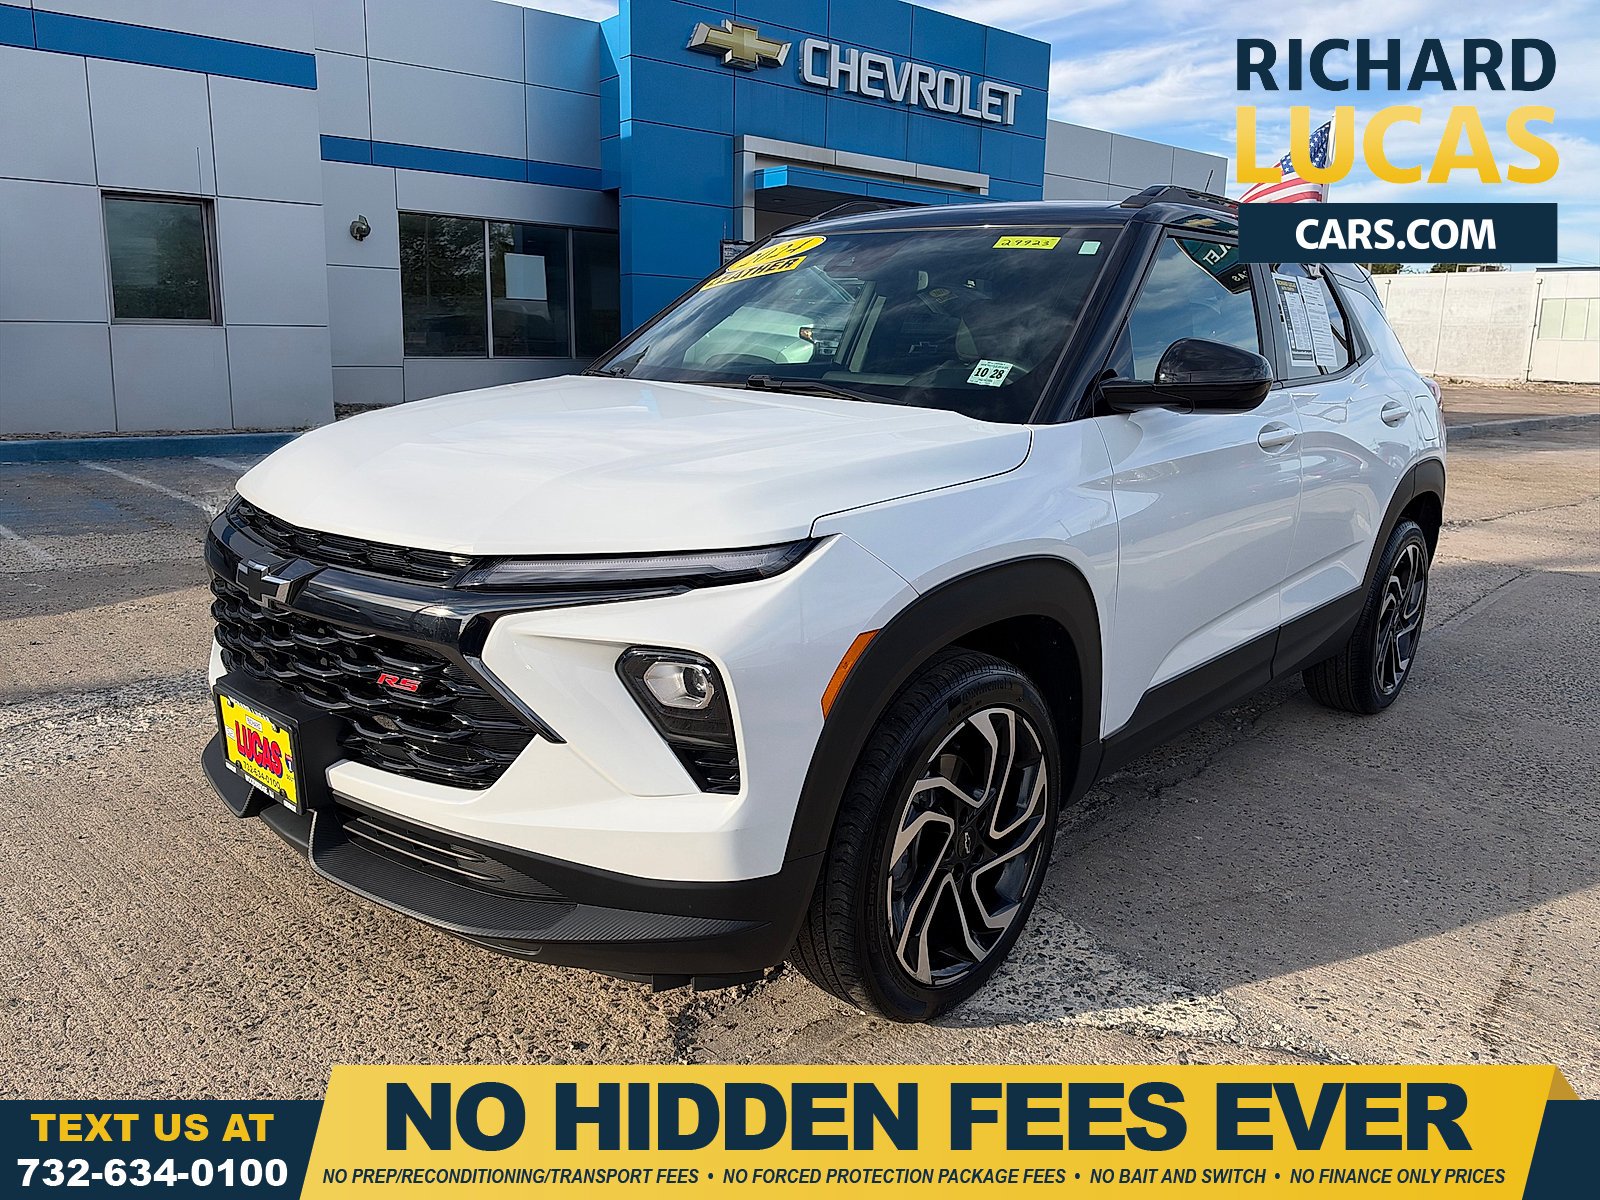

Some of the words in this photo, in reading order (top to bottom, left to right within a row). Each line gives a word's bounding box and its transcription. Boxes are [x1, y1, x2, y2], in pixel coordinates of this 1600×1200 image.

[801, 38, 1022, 126] CHEVROLET
[702, 257, 800, 288] LEATHER
[974, 367, 989, 377] 10
[989, 369, 1004, 379] 28
[377, 672, 421, 692] RS
[234, 720, 283, 779] LUCAS
